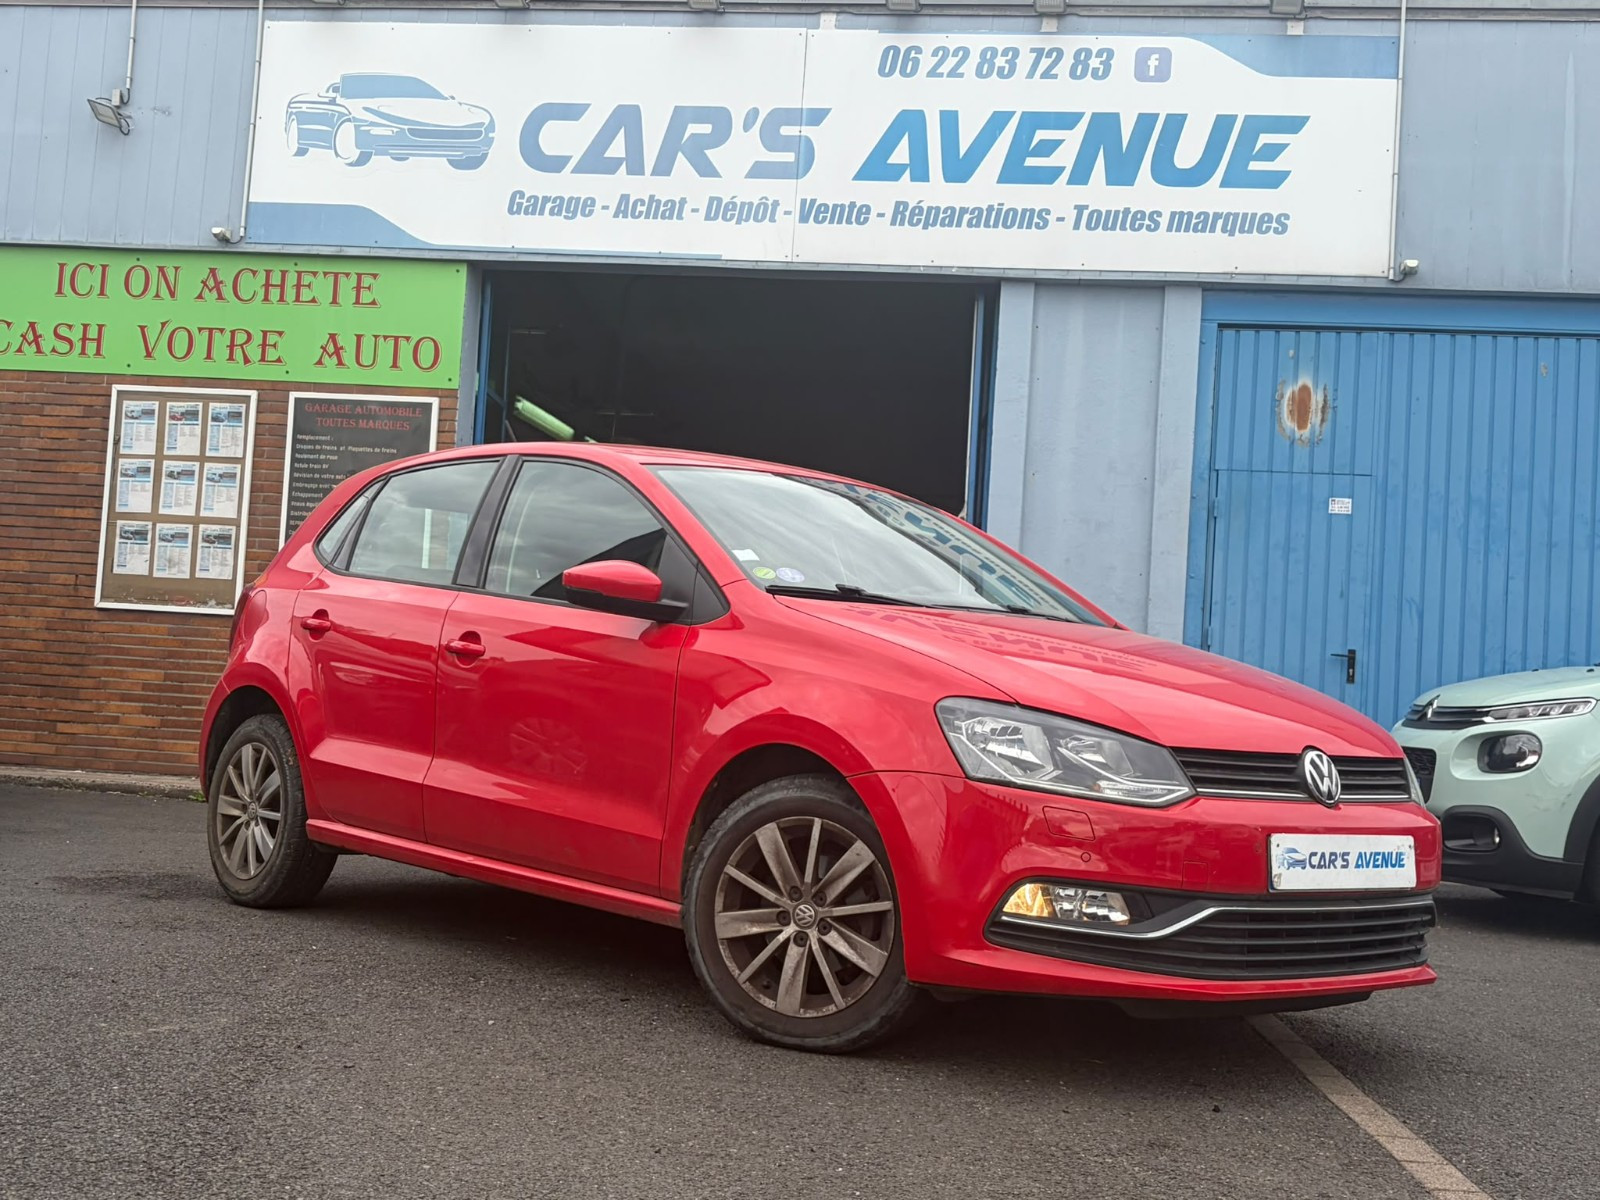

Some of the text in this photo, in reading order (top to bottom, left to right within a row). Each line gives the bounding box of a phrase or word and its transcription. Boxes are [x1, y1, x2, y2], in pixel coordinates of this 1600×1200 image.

[876, 44, 1115, 81] 06 22 83 72 83
[518, 101, 1312, 190] CAR'S AVENUE
[507, 189, 597, 221] Garage
[612, 193, 688, 221] Achat
[703, 195, 780, 226] Dépôt
[798, 198, 871, 226] Vente
[890, 199, 1052, 231] Réparations
[1071, 204, 1162, 233] Toutes
[1166, 209, 1291, 237] marques
[54, 262, 382, 309] ICI ON ACHETE
[137, 318, 287, 367] VOTRE
[312, 331, 443, 373] AUTO
[304, 402, 424, 418] GARAGE AUTOMOBILE
[316, 417, 411, 431] TOUTES MARQUES
[1308, 851, 1406, 870] CAR'S AVENUE
